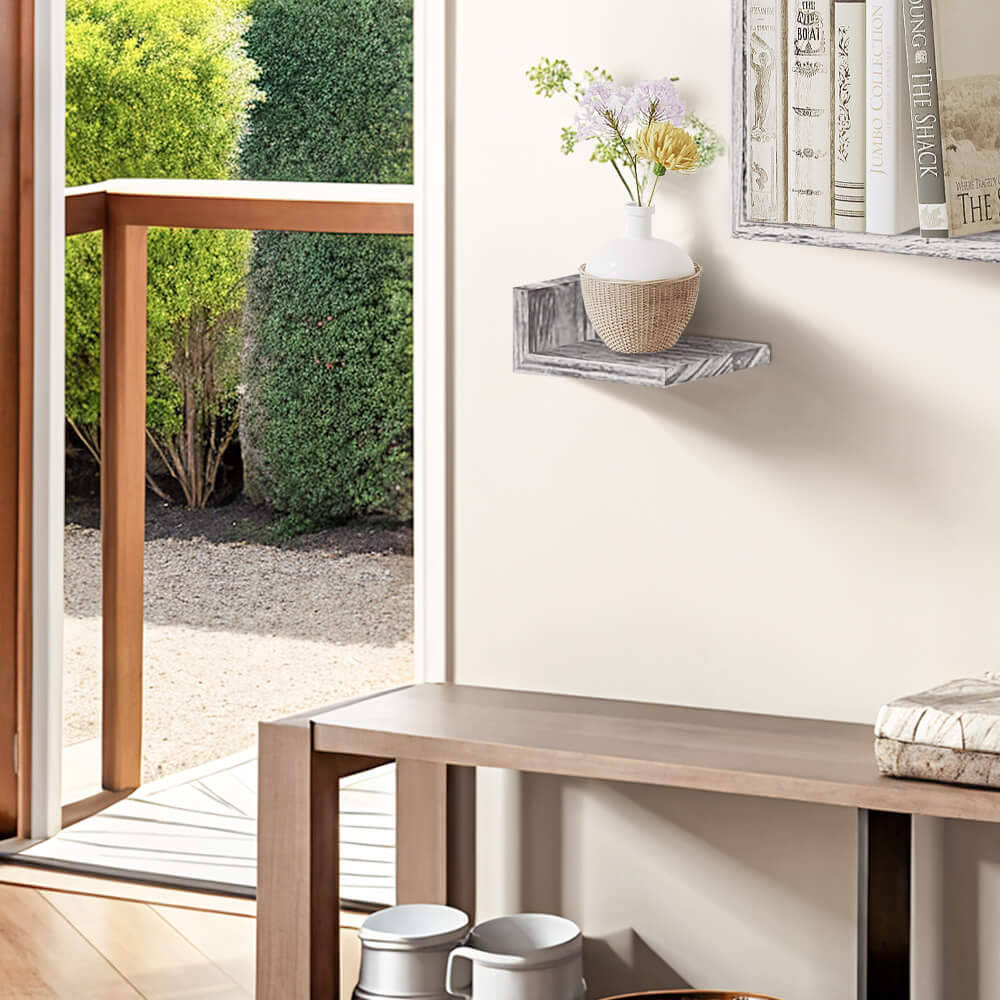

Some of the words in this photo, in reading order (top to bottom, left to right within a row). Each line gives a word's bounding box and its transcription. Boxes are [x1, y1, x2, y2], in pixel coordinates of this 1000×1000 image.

[871, 4, 884, 112] COLLECTION
[911, 68, 932, 107] THE
[870, 117, 888, 176] JUMBO
[915, 114, 937, 177] SHACK
[957, 193, 992, 224] THE
